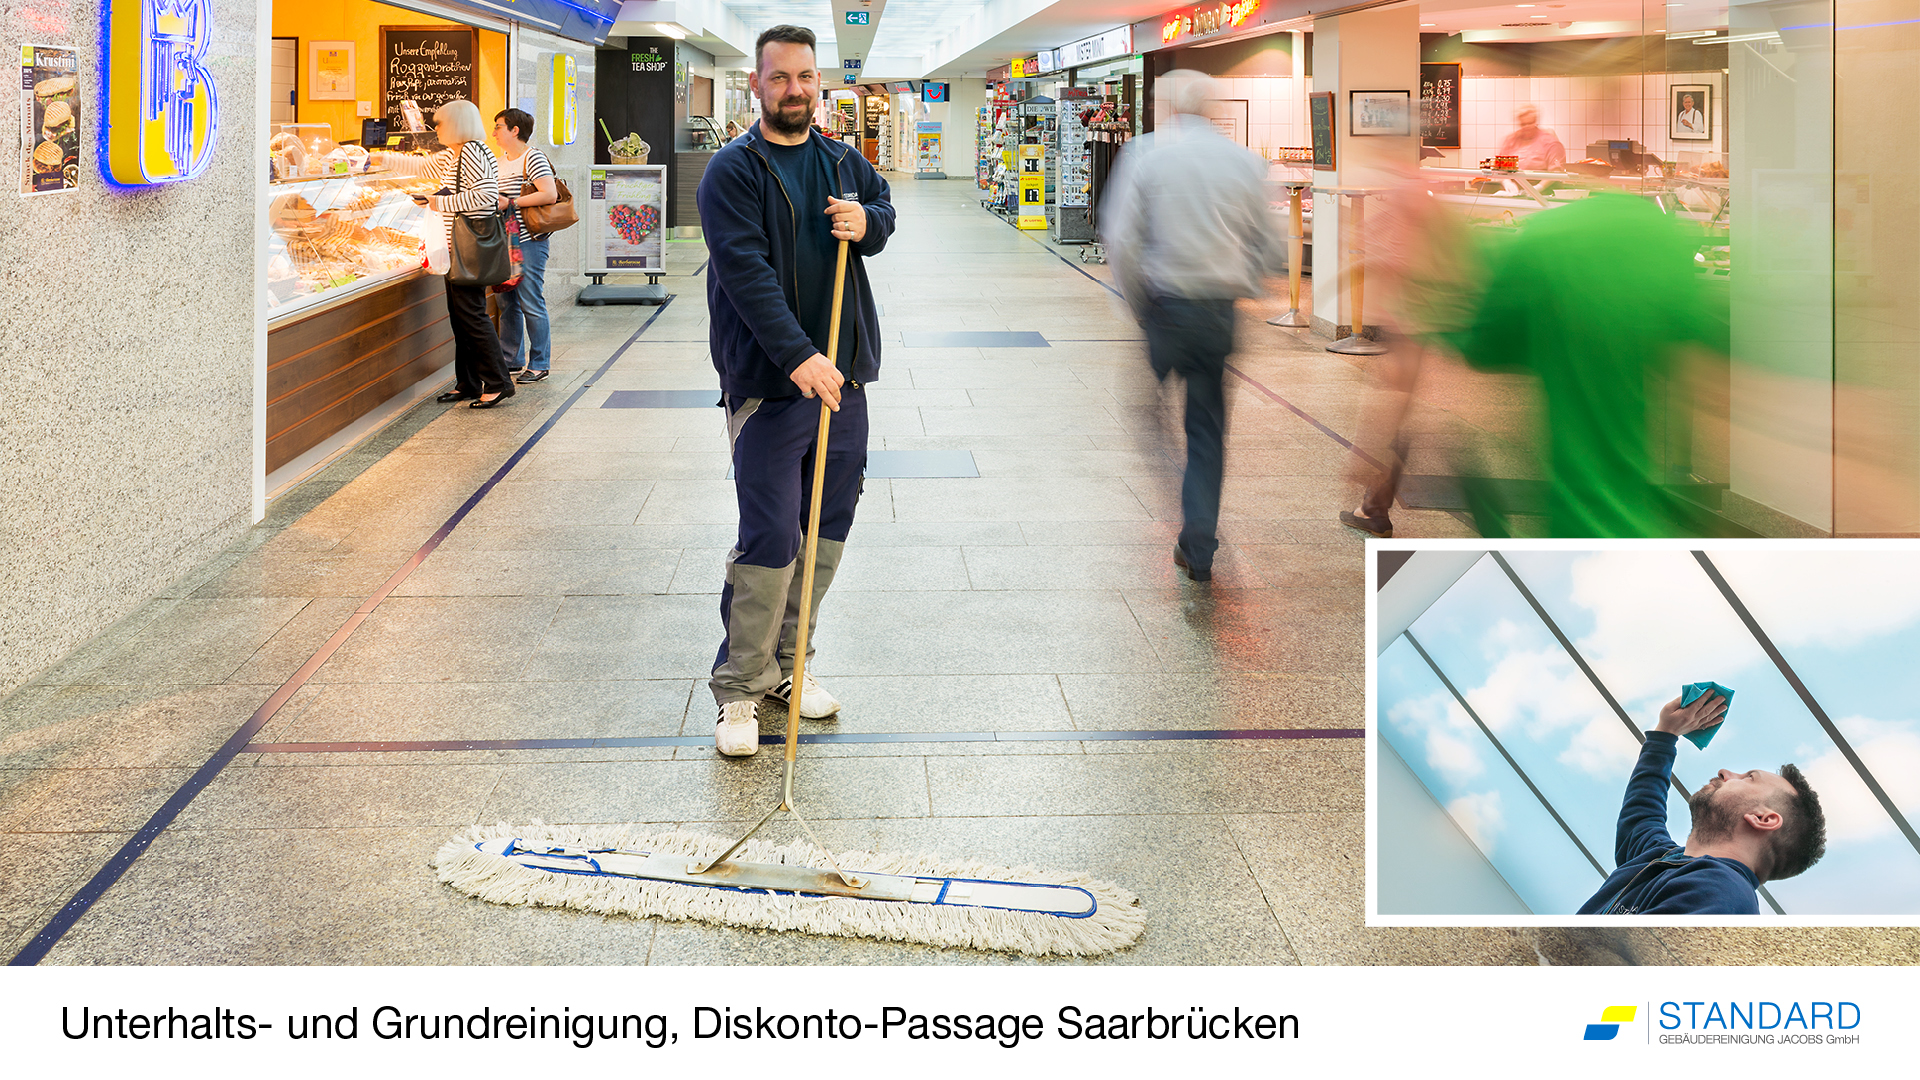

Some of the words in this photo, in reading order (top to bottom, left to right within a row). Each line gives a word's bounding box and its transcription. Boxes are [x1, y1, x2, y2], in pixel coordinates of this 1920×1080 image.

[394, 41, 419, 57] Unsere
[419, 40, 458, 61] Empfehlung
[35, 52, 75, 68] Krustini
[631, 53, 655, 62] FRESH
[631, 62, 646, 72] TEA
[646, 62, 666, 72] SHOP
